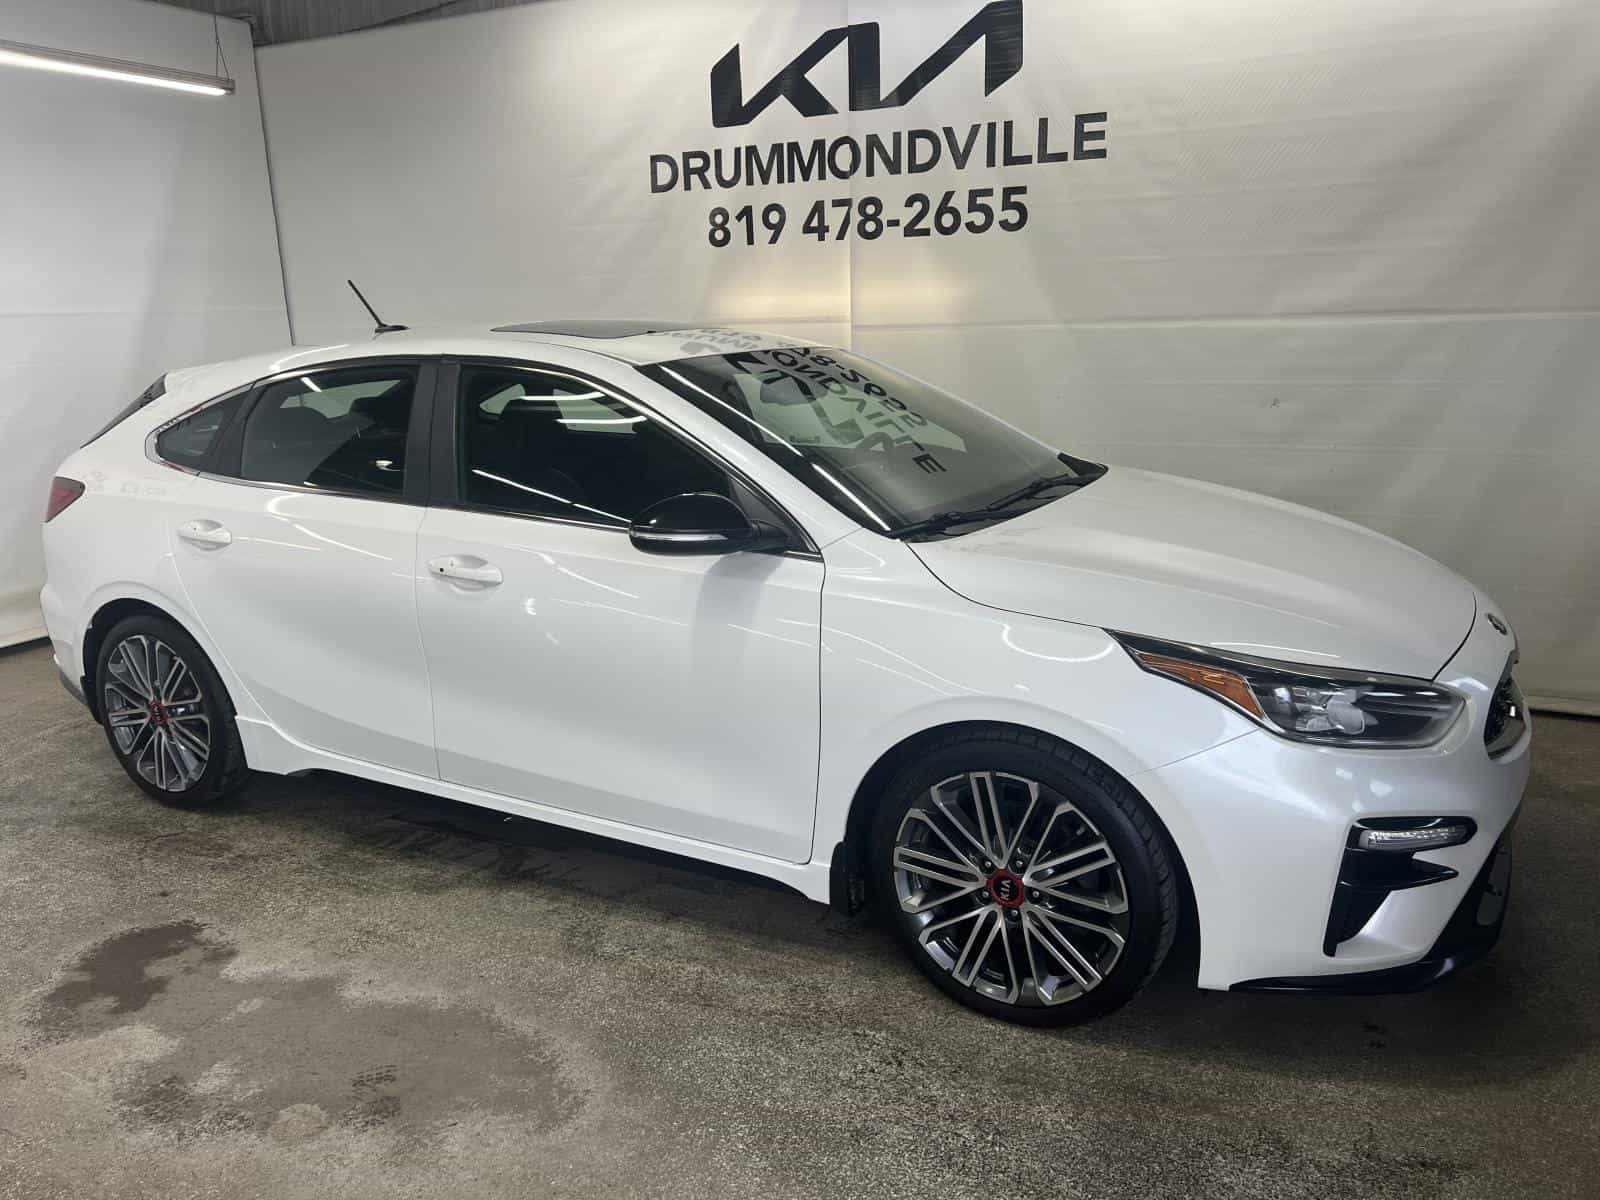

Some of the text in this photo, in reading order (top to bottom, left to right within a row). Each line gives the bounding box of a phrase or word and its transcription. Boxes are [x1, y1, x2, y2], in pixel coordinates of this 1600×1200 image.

[711, 0, 1024, 128] KIA
[650, 112, 1108, 194] DRUMMONDVILLE
[708, 186, 1029, 249] 819 478-2655
[1000, 880, 1011, 901] KIA
